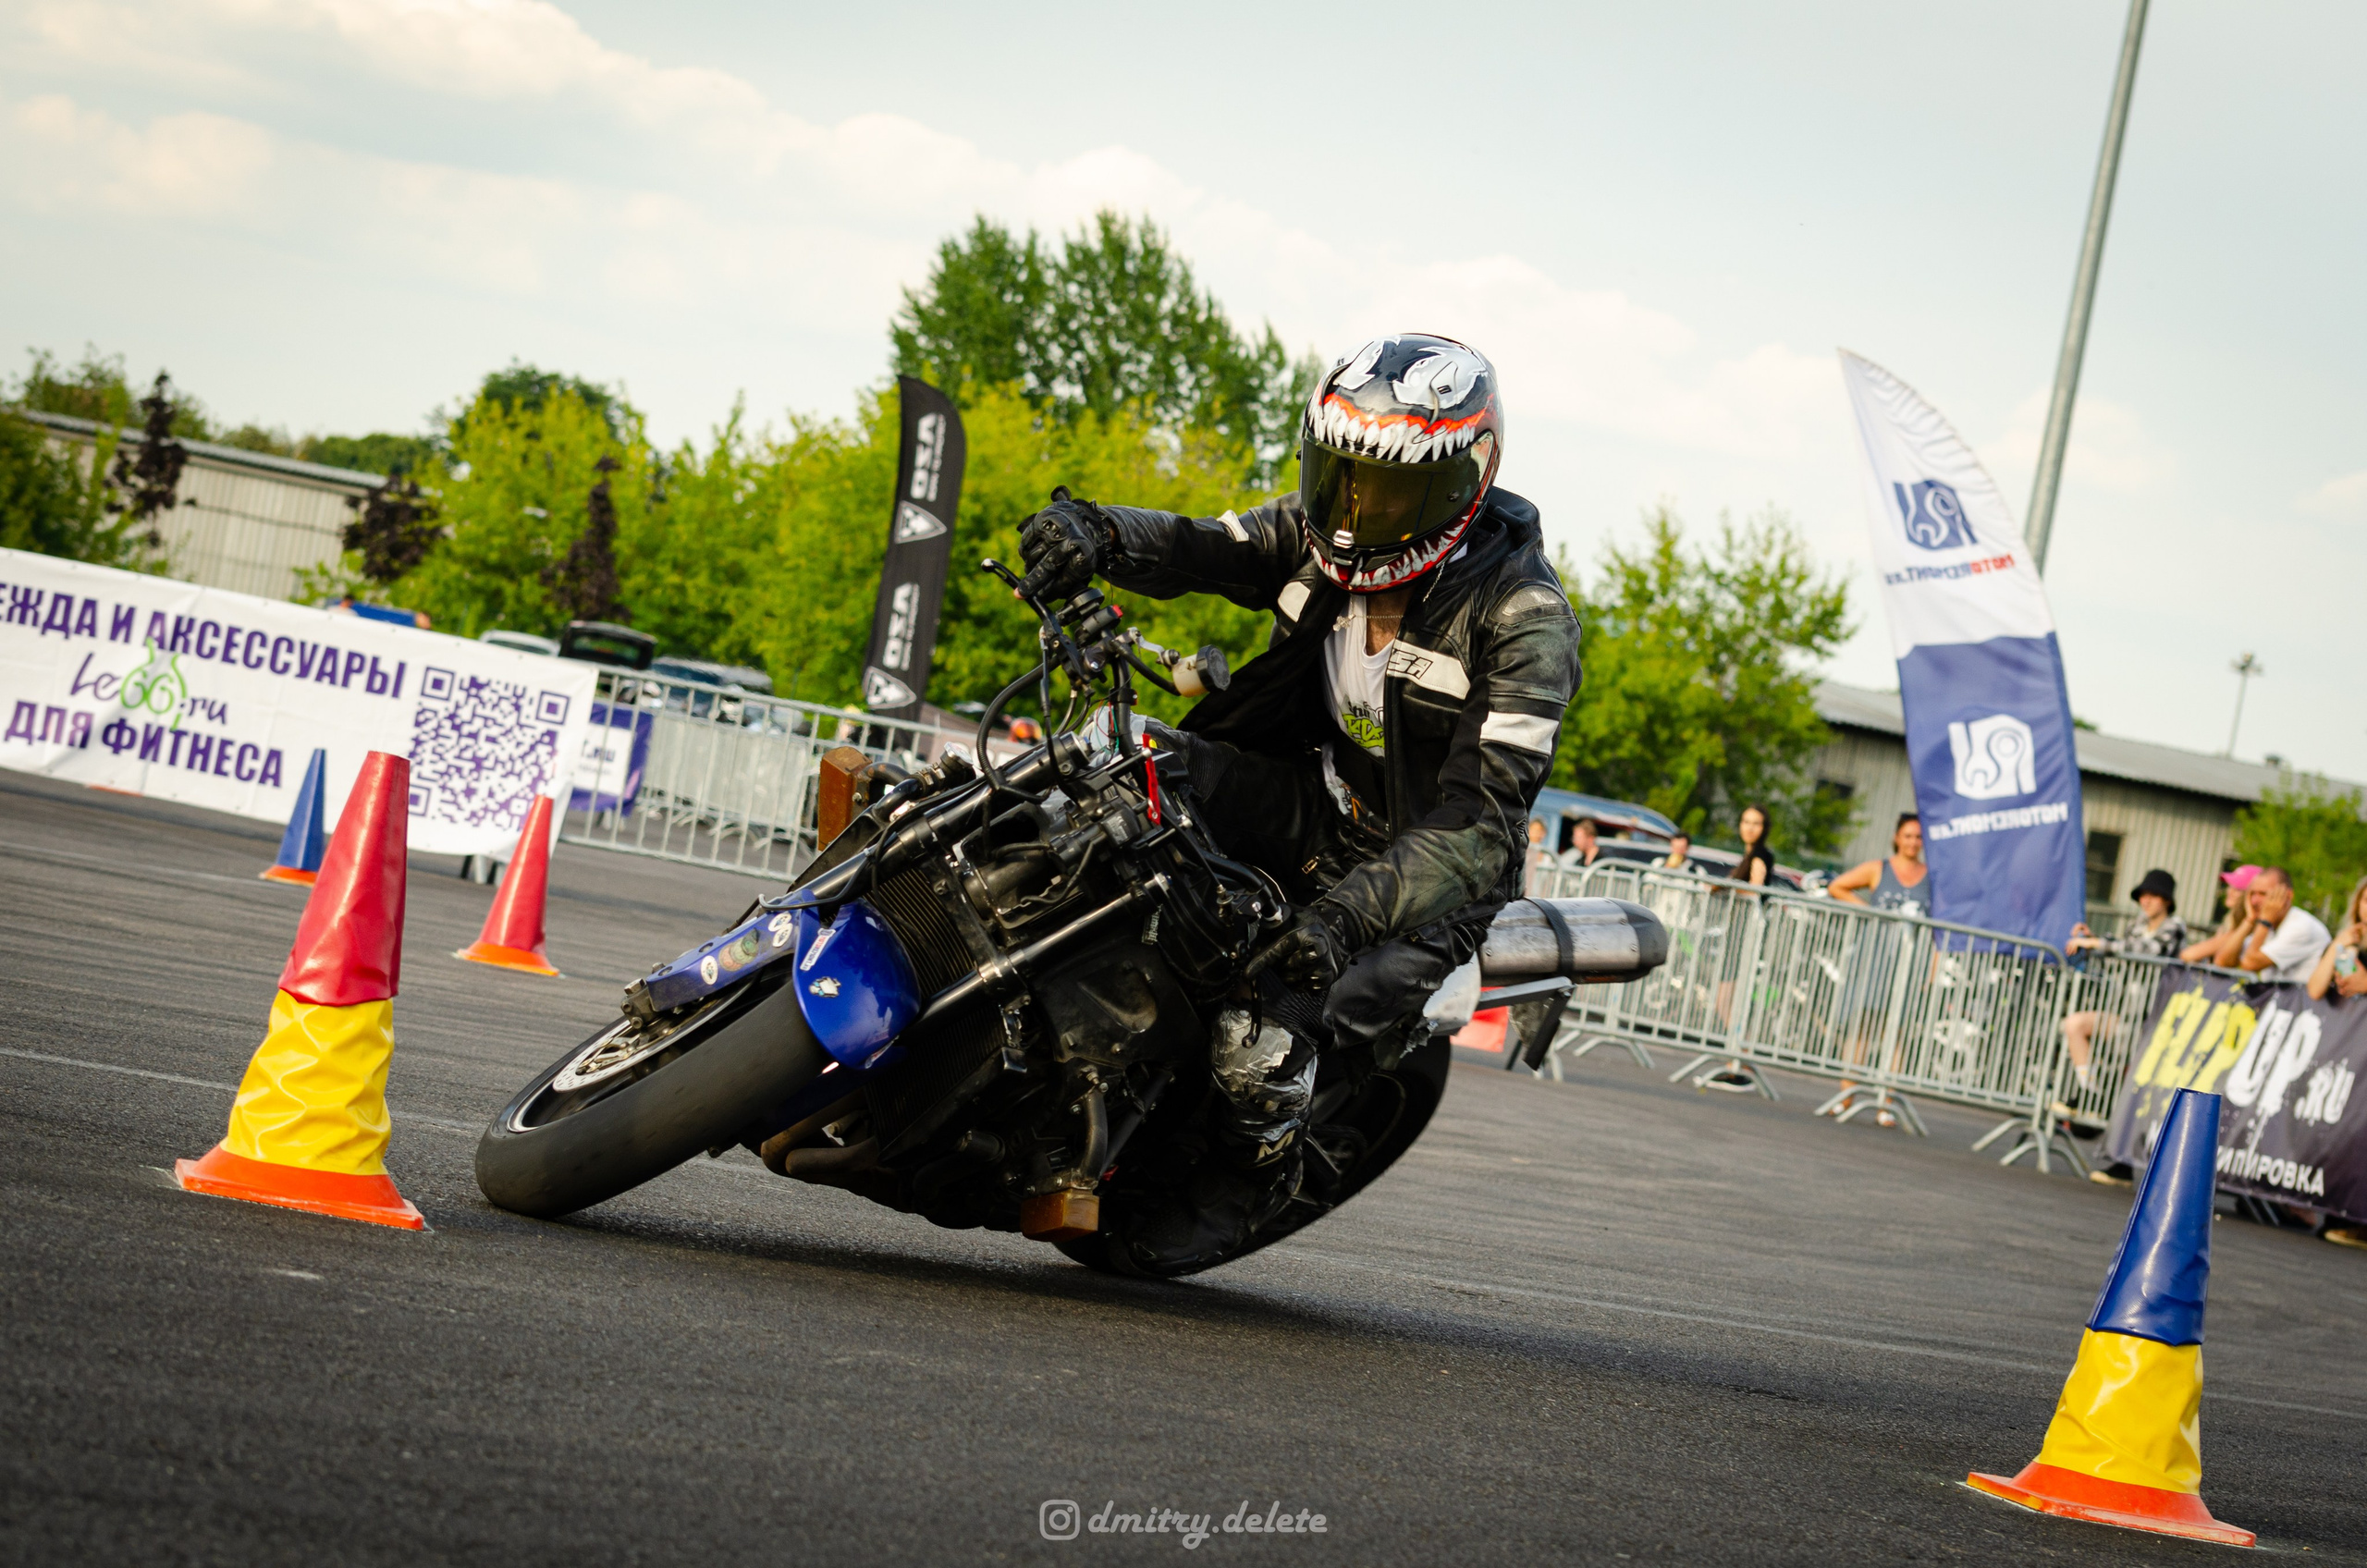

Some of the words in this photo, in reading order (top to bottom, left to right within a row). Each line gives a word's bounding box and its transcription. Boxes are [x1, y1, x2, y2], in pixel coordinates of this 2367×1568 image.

[109, 604, 136, 643] И
[142, 610, 407, 699] АКСЕССУАРЫ
[5, 700, 95, 750] ДЛЯ
[102, 717, 283, 788] ФИТНЕСА
